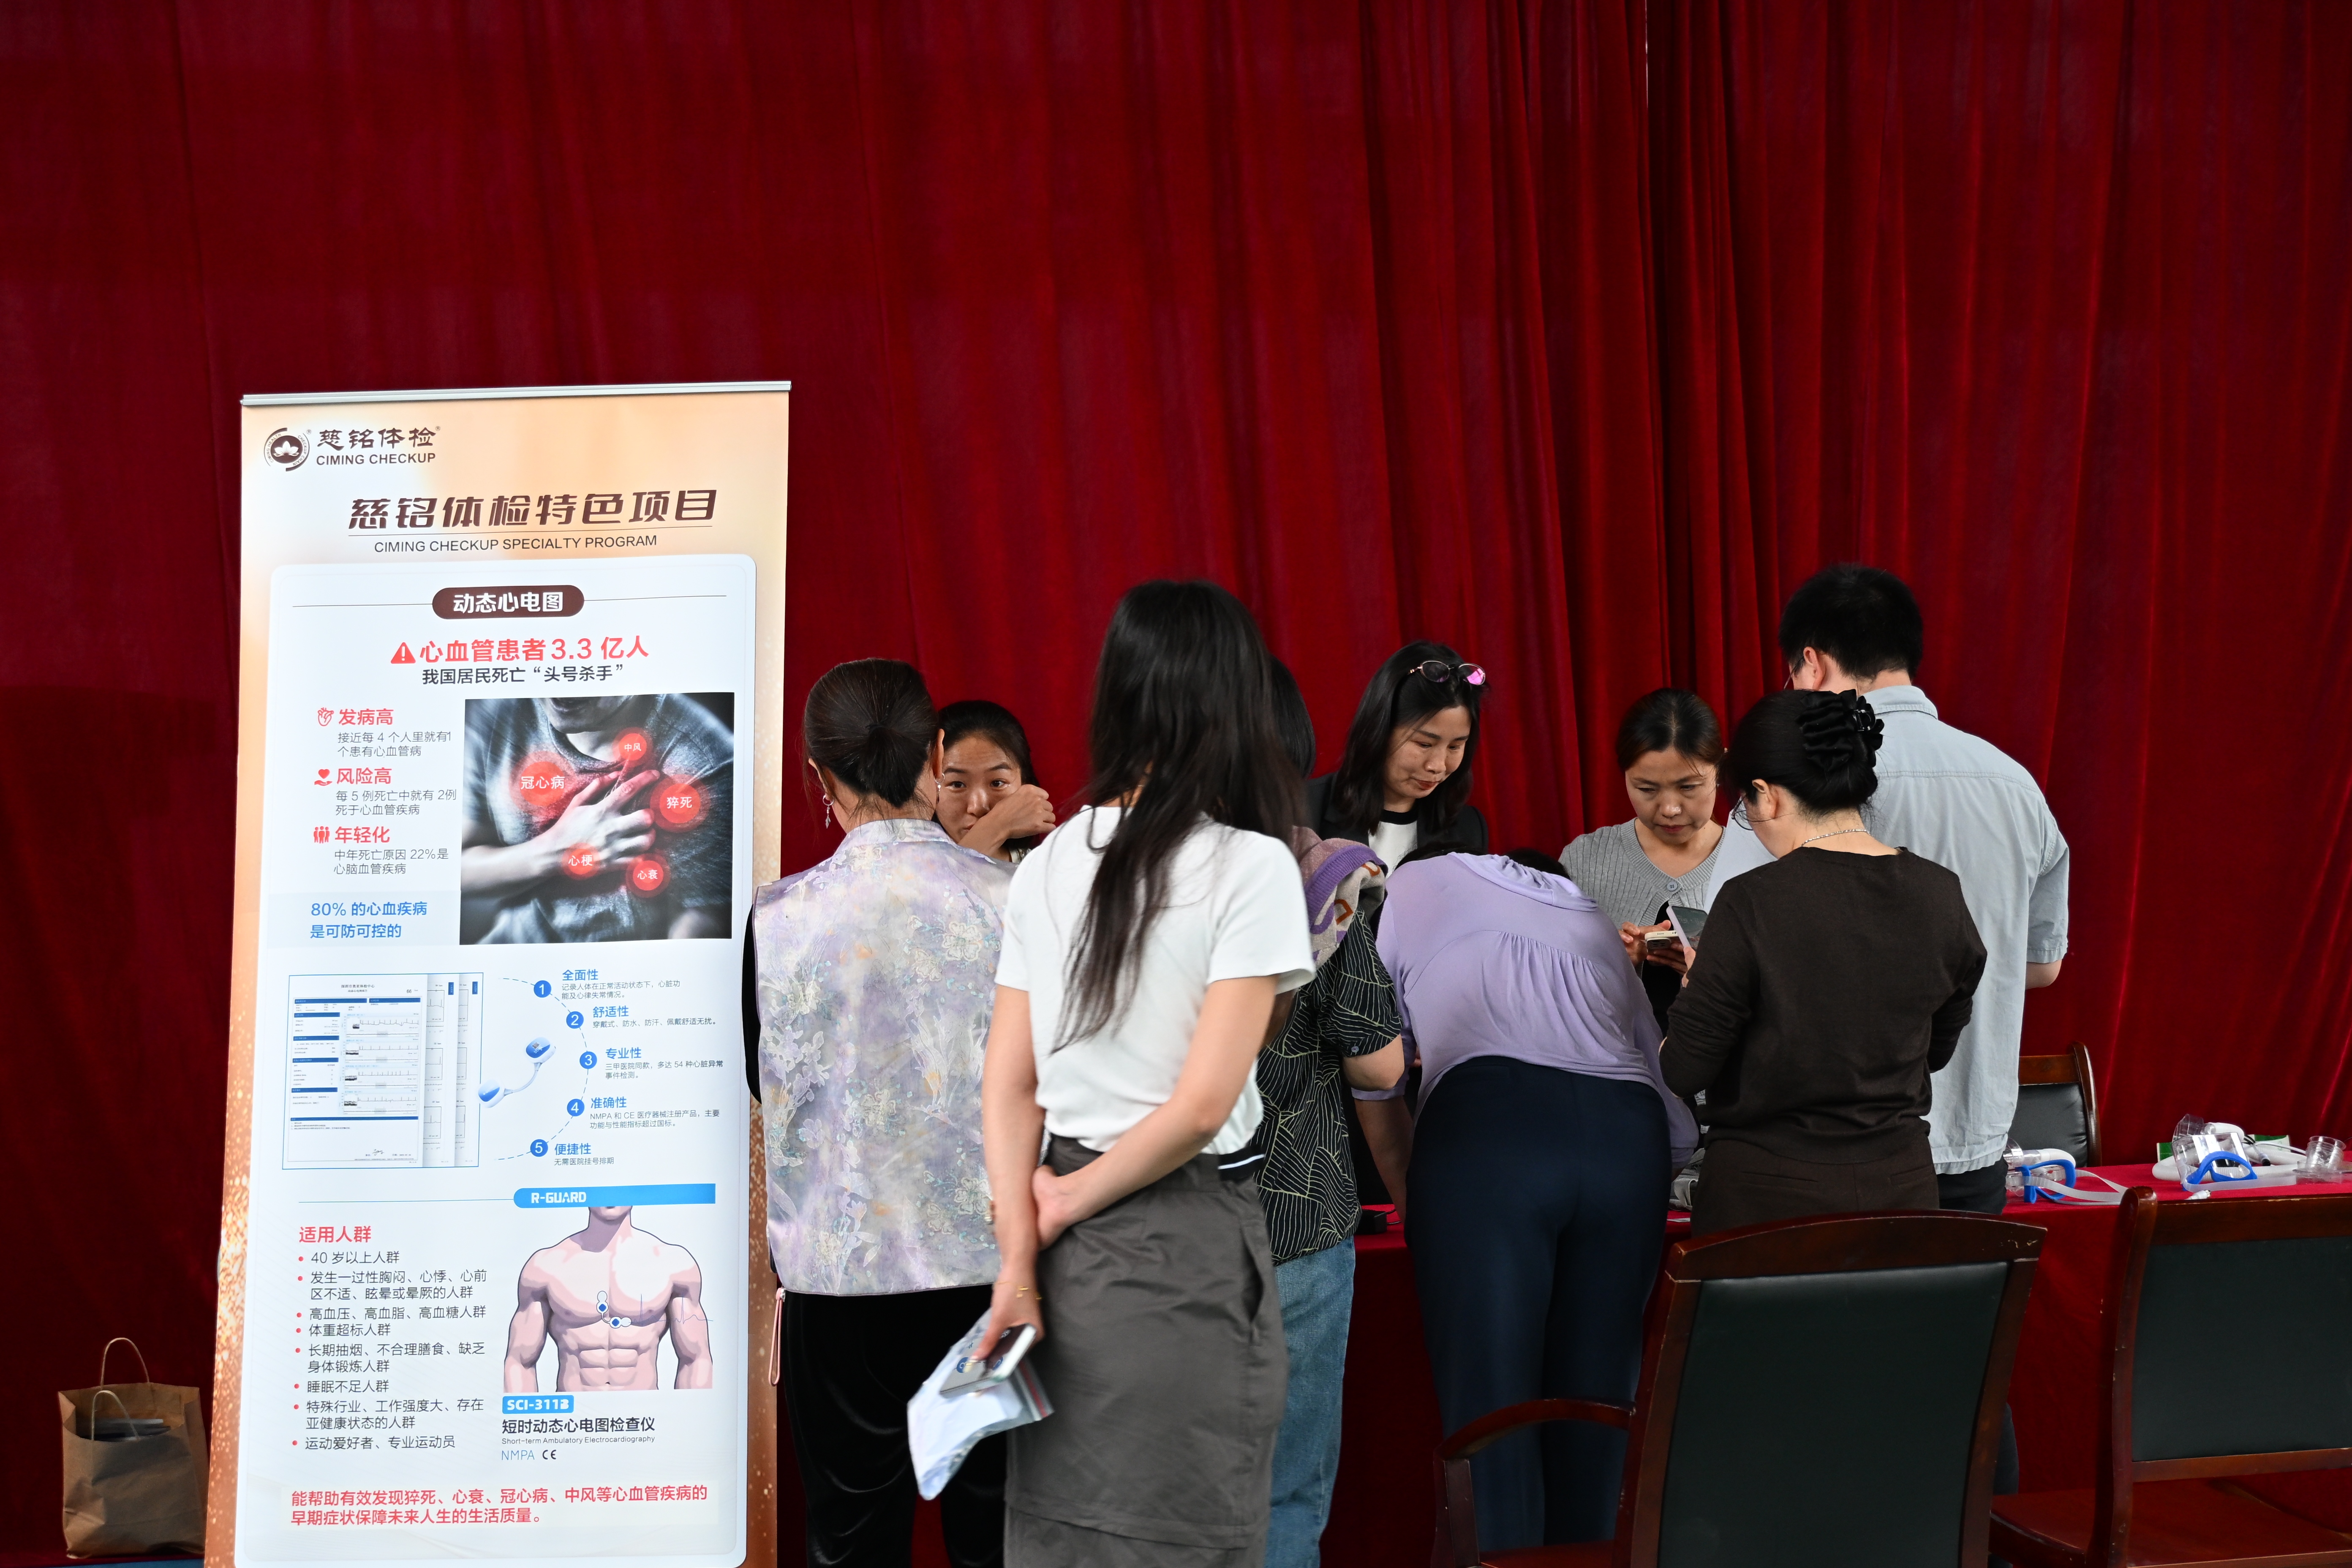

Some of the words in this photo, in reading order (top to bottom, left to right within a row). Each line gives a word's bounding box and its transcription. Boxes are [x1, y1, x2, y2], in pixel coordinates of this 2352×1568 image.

[317, 427, 436, 451] 慈铭体检
[317, 455, 364, 465] CIMING
[370, 453, 436, 464] CHECKUP
[348, 490, 717, 530] 慈铭体检特色项目
[375, 542, 425, 552] CIMING
[430, 540, 498, 551] CHECKUP
[503, 538, 581, 549] SPECIALTY
[585, 535, 656, 548] PROGRAM
[453, 592, 563, 614] 动态心电图
[339, 708, 393, 725] 发病高
[338, 746, 421, 757] 个患有心血管病
[624, 743, 642, 753] 中风
[337, 768, 392, 784] 风险高
[521, 776, 564, 789] 冠心病
[336, 804, 419, 815] 死于心血管疾病
[667, 797, 694, 810] 猝死
[335, 826, 390, 843] 年轻化
[568, 855, 593, 866] 心梗
[334, 863, 406, 874] 心脑血管疾病
[637, 869, 658, 881] 心衰
[311, 903, 346, 916] 80%
[352, 901, 427, 916] 的心血疾病
[310, 924, 401, 938] 是可防可控的
[563, 969, 598, 981] 全面性
[539, 984, 544, 994] 1
[593, 1005, 629, 1018] 舒适性
[571, 1015, 579, 1025] 2
[606, 1047, 641, 1059] 专业性
[585, 1055, 592, 1066] 3
[571, 1102, 579, 1113] 4
[591, 1097, 626, 1109] 准确性
[535, 1142, 542, 1153] 5
[555, 1143, 591, 1155] 便捷性
[554, 1157, 614, 1165] 无需医院挂号排期
[531, 1192, 586, 1203] R-GUARD
[299, 1226, 371, 1243] 适用人群
[311, 1252, 327, 1263] 40
[332, 1251, 399, 1264] 岁以上人群
[311, 1269, 487, 1284] 发生一过性胸闷、心悸、心前
[311, 1286, 473, 1300] 区不适、眩晕或晕厥的人群
[310, 1305, 486, 1320] 高血压、高血脂、高血糖人群
[309, 1323, 390, 1337] 体重超标人群
[309, 1342, 485, 1356] 长期抽烟、不合理膳食、缺乏
[308, 1360, 389, 1373] 身体锻炼人群
[308, 1380, 389, 1393] 睡眠不足人群
[307, 1398, 484, 1413] 特殊行业、工作强度大、存在
[507, 1399, 569, 1410] SCI-311B
[306, 1416, 415, 1429] 亚健康状态的人群
[502, 1417, 655, 1434] 短时动态心电图检查仪
[305, 1435, 455, 1450] 运动爱好者、专业运动员
[502, 1450, 534, 1460] NMPA
[292, 1485, 707, 1506] 能帮助有效发现猝死、心衰、冠心病、中风等心血管疾病的
[291, 1508, 539, 1525] 早期症状保障未来人生的生活质量。
